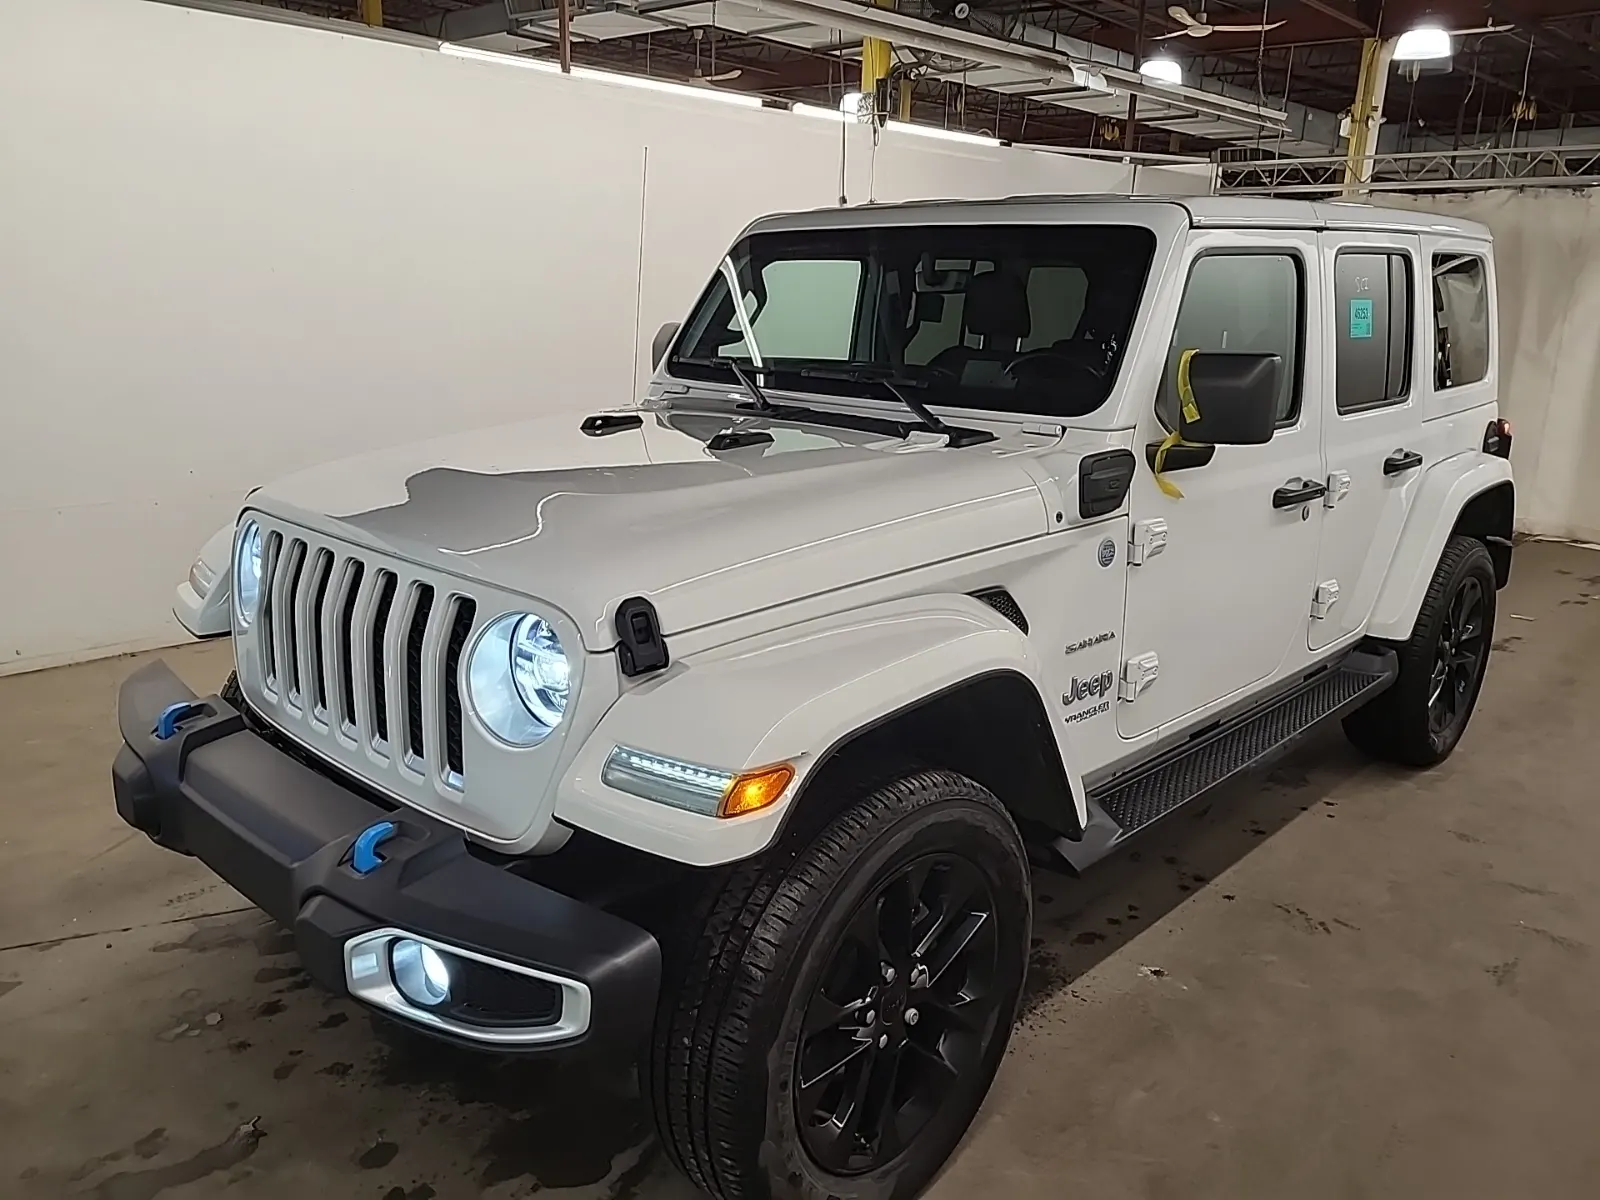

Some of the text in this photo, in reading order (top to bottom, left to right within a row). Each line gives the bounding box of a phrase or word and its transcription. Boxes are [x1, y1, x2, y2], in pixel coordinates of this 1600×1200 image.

[1064, 631, 1116, 655] SAHARA
[1062, 670, 1113, 706] Jeep
[1064, 701, 1110, 724] WRANGLER
